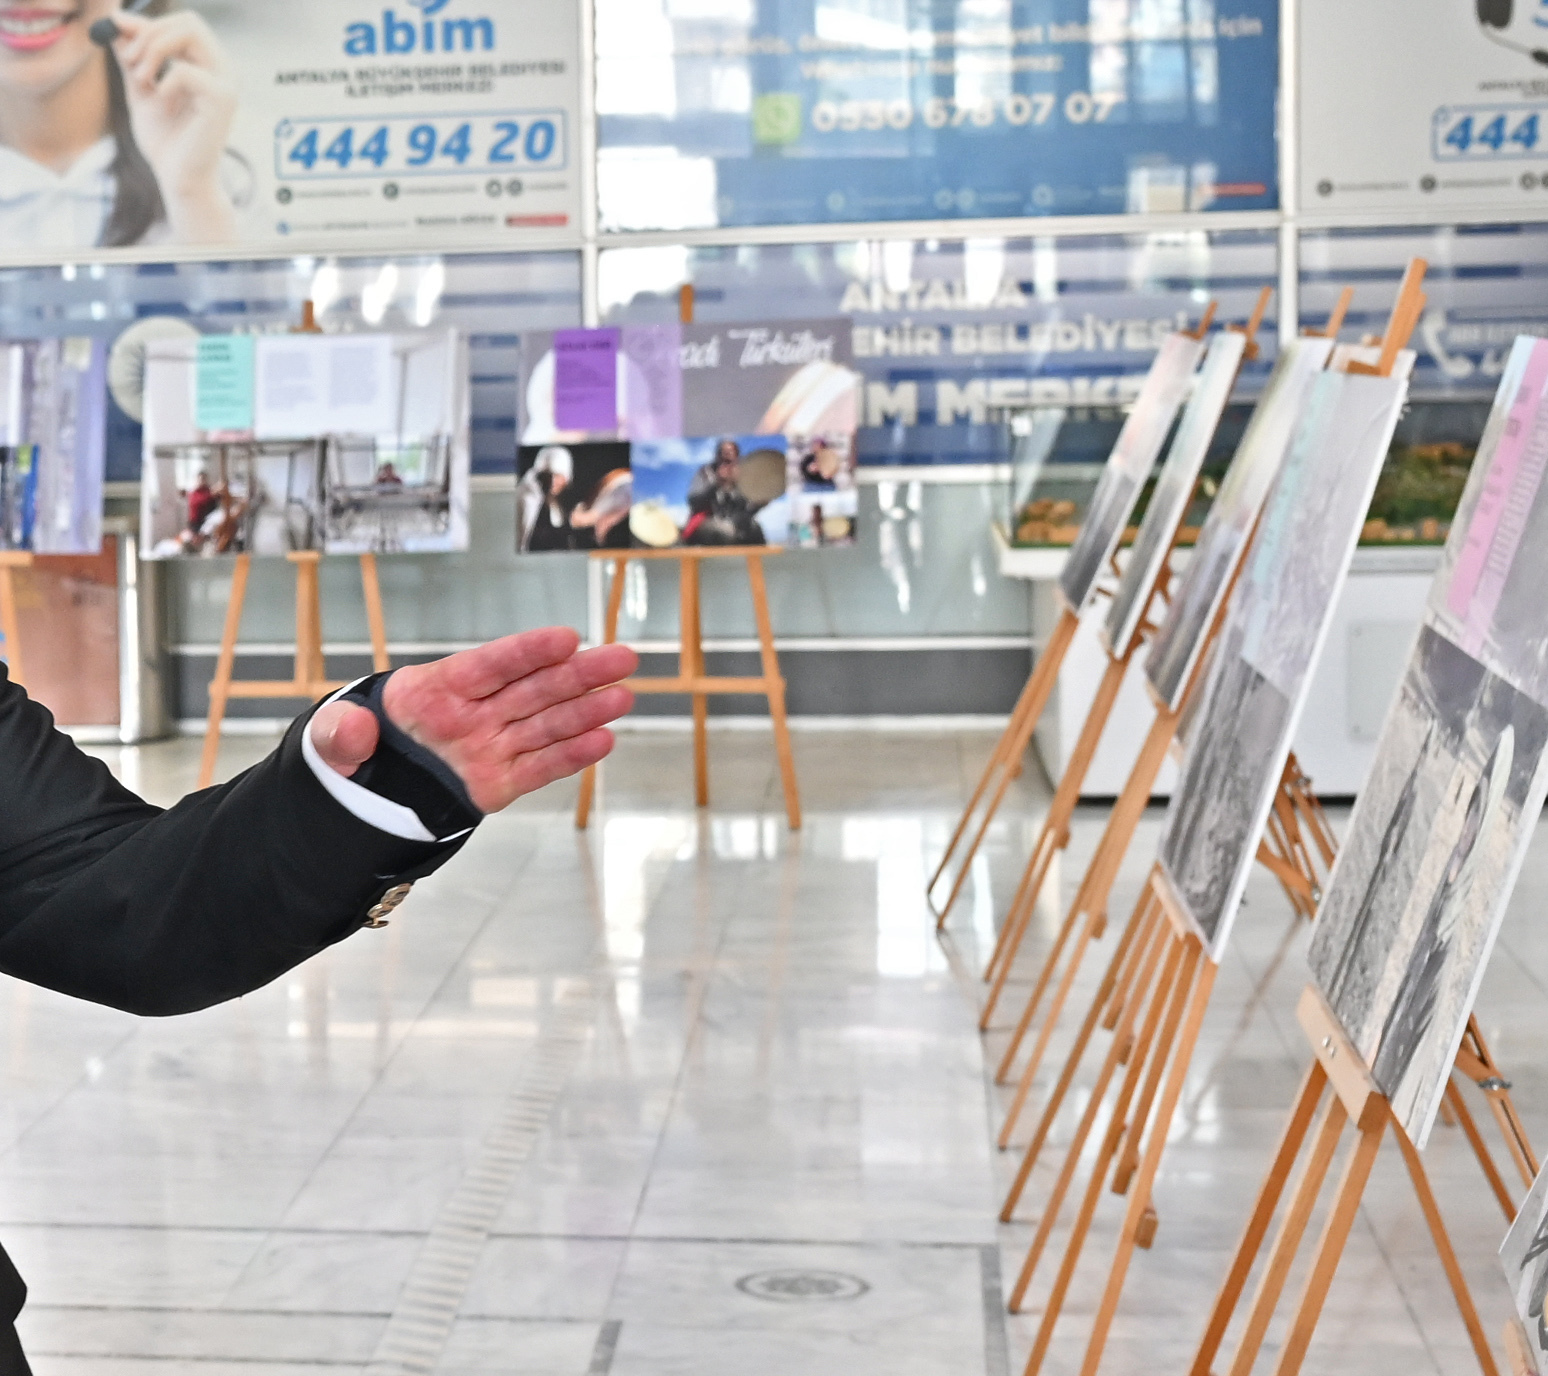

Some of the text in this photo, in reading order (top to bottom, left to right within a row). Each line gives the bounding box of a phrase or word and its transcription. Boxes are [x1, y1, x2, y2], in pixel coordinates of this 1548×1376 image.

[342, 9, 496, 57] abim
[1005, 93, 1056, 125] 07
[288, 119, 556, 169] 444 94 20
[1444, 112, 1541, 152] 444
[839, 278, 1027, 312] ANTALA
